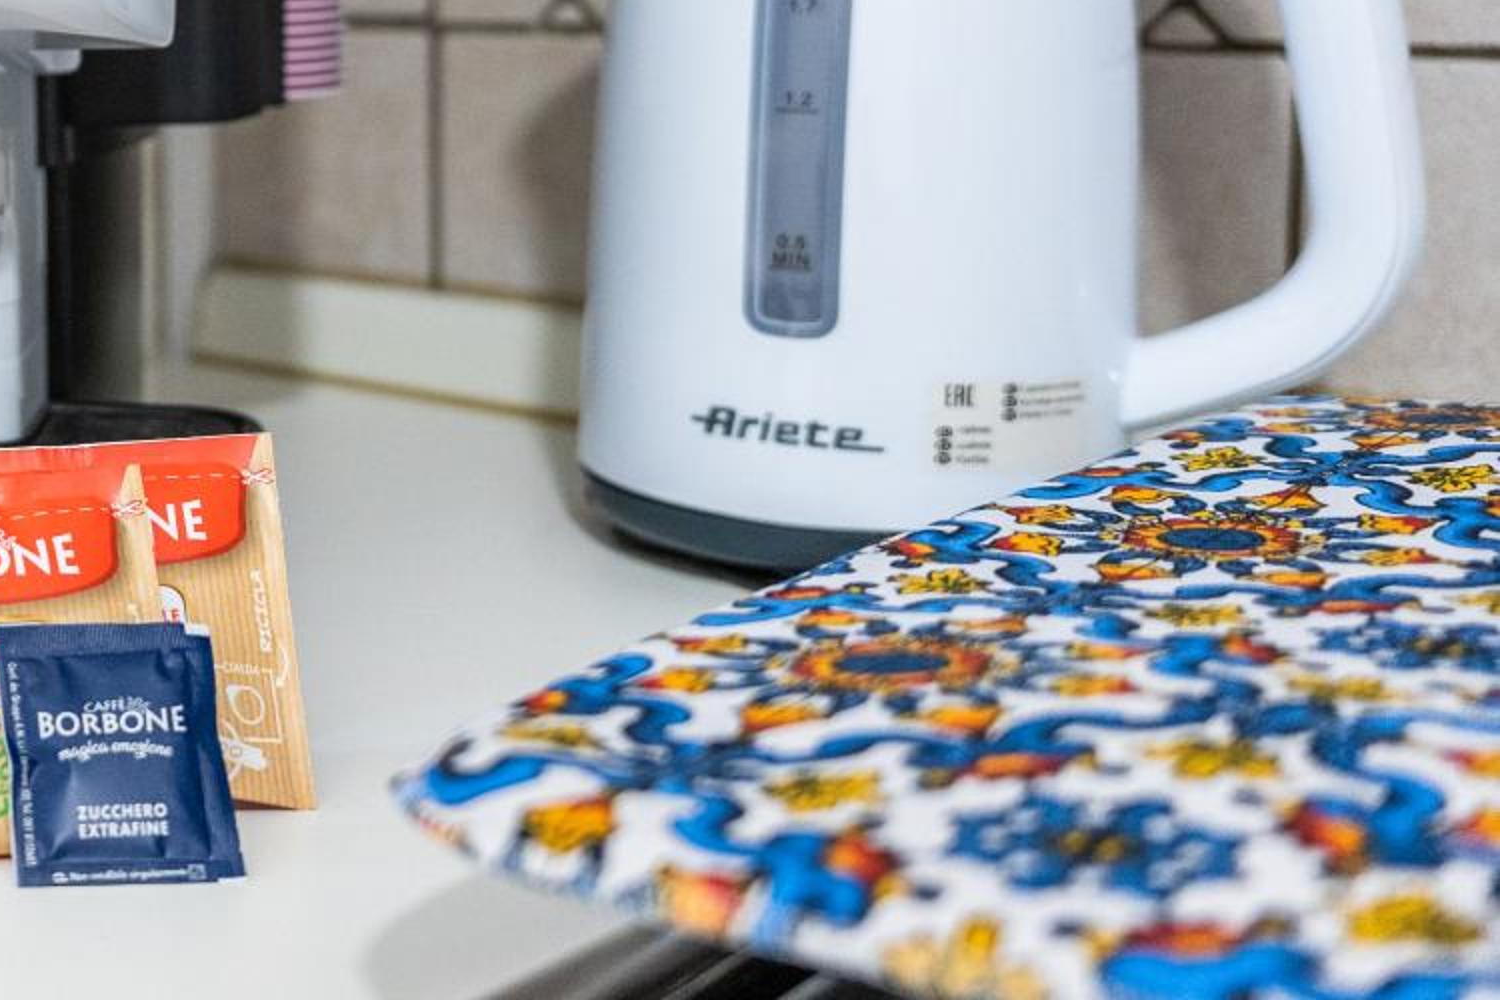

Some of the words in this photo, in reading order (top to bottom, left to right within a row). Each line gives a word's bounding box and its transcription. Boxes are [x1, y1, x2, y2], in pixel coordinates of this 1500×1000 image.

[692, 405, 885, 453] Ariete
[146, 498, 208, 542] NE
[37, 704, 188, 741] BORBONE
[76, 802, 169, 822] ZUCCHERO
[78, 819, 170, 840] EXTRAFINE
